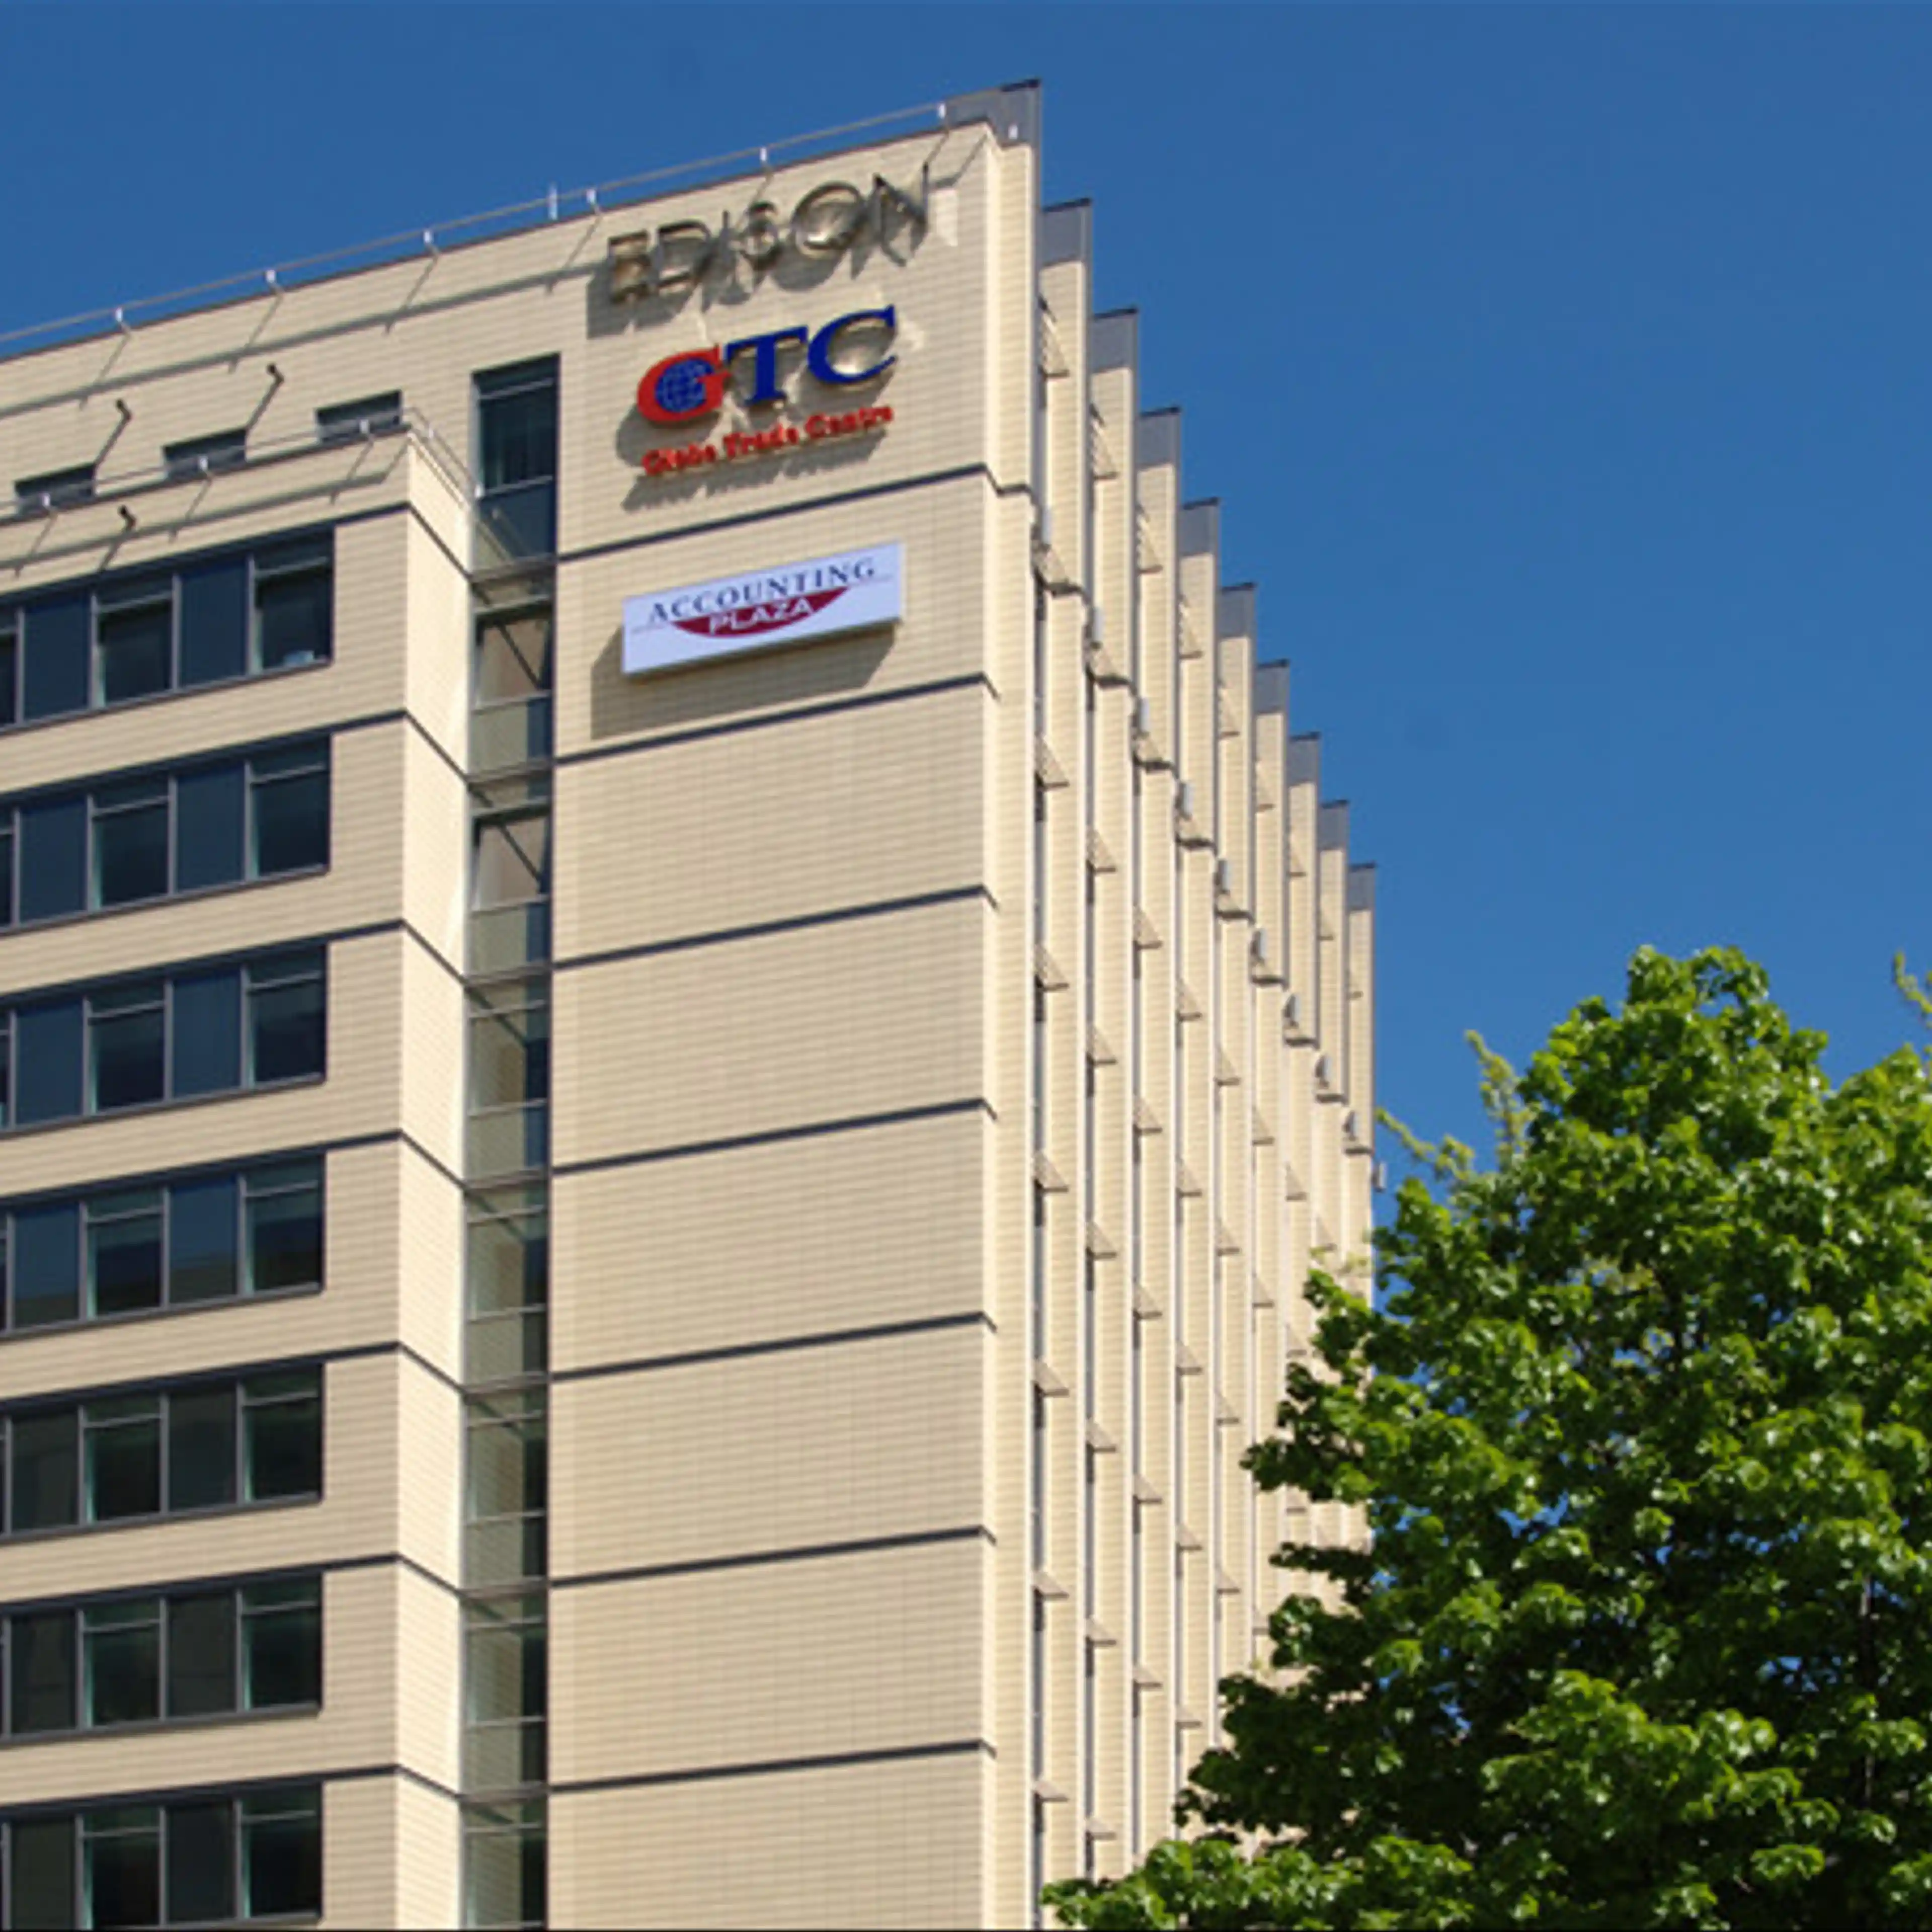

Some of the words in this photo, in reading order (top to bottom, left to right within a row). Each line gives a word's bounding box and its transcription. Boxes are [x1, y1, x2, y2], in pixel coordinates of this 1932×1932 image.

[608, 162, 929, 303] EDISON
[637, 305, 896, 423] GTC
[641, 443, 717, 476] Globe
[722, 424, 799, 459] Trade
[805, 406, 894, 439] Centre
[649, 557, 874, 624] ACCOUNTING
[709, 599, 815, 635] PLAZA
